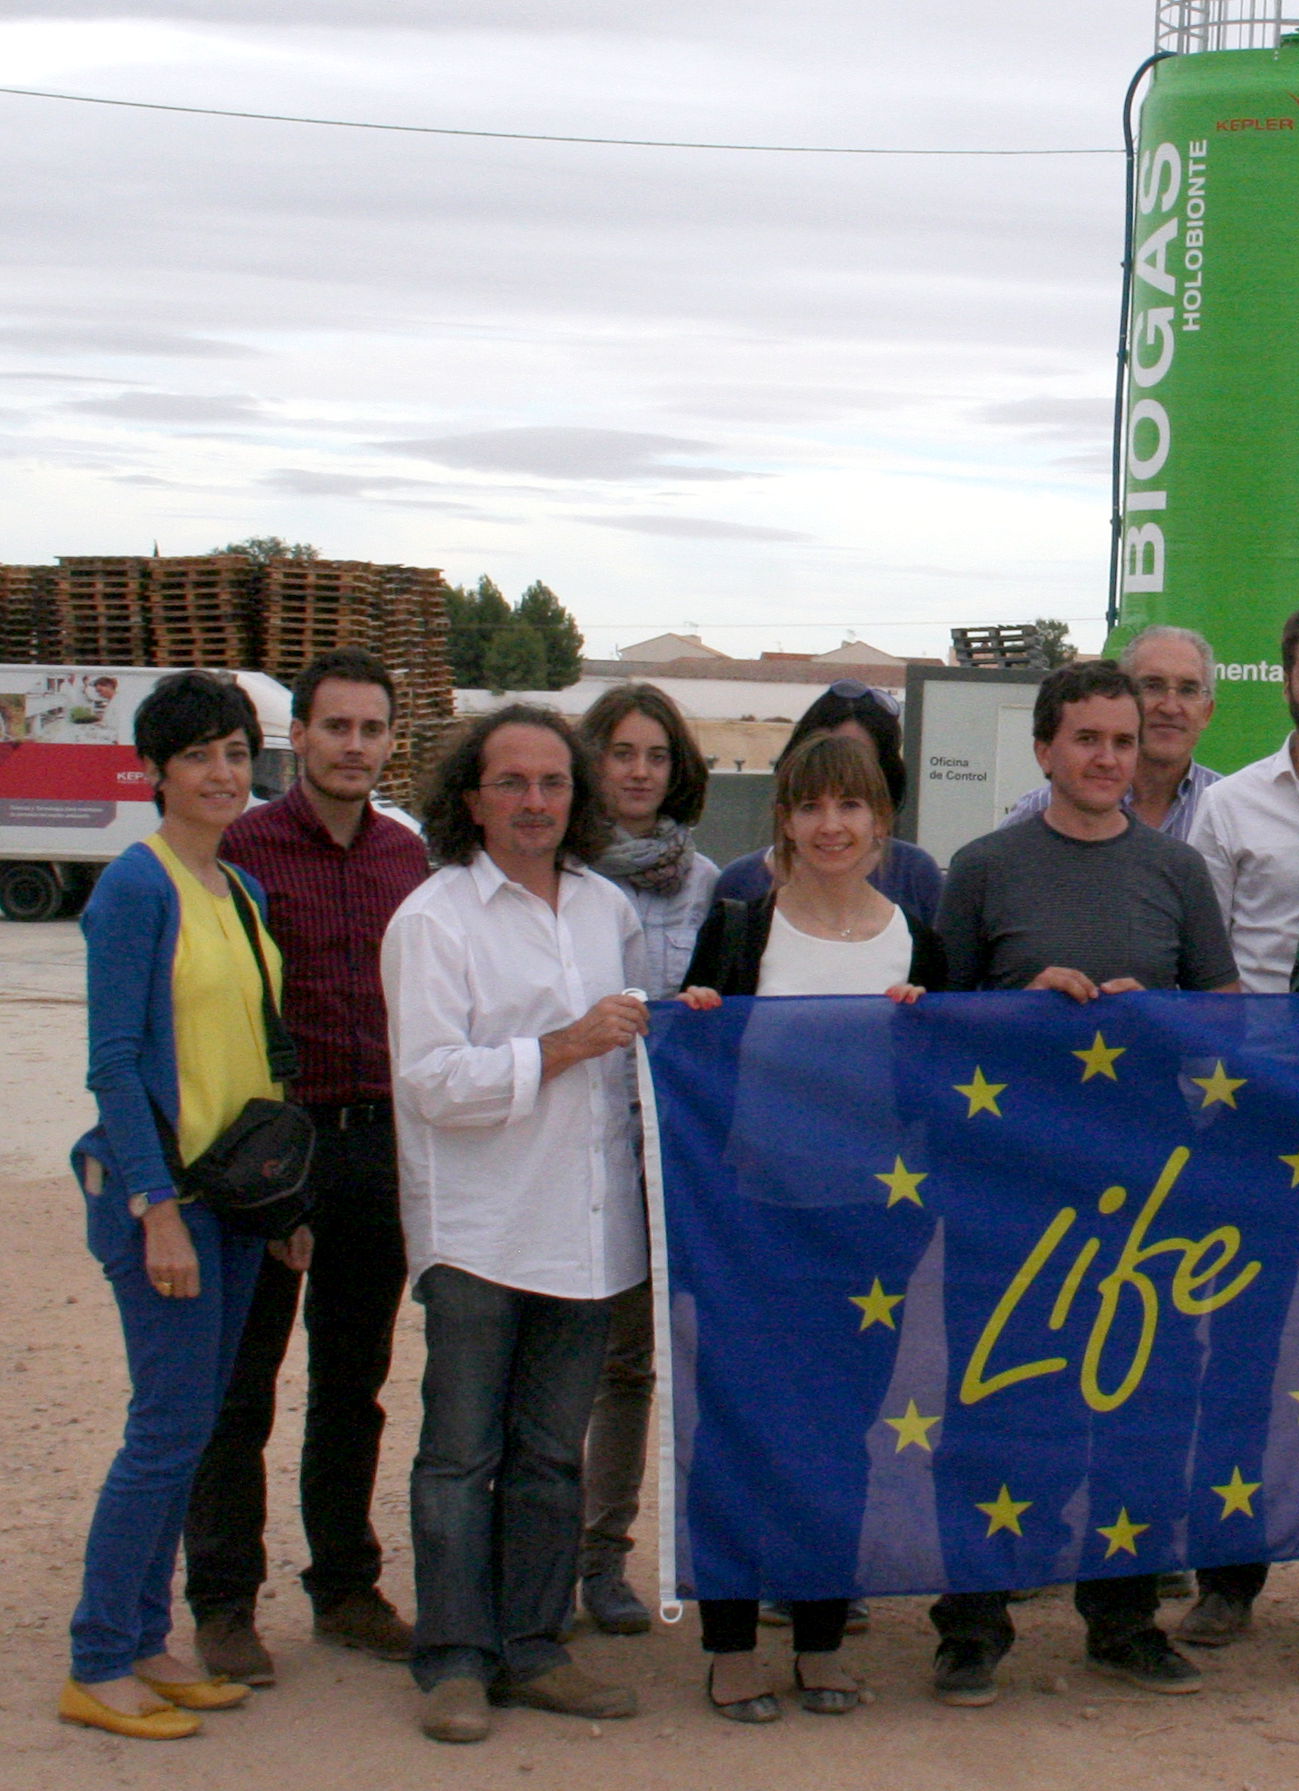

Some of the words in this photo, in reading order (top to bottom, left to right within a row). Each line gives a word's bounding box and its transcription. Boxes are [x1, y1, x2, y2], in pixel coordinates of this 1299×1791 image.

[1216, 118, 1294, 131] KEPLER
[1182, 138, 1208, 332] HOLOBIONTE
[1121, 142, 1183, 594] BIOGAS
[929, 756, 969, 767] Oficina
[929, 770, 943, 780] de
[946, 770, 987, 782] Control
[959, 1146, 1262, 1412] Life
